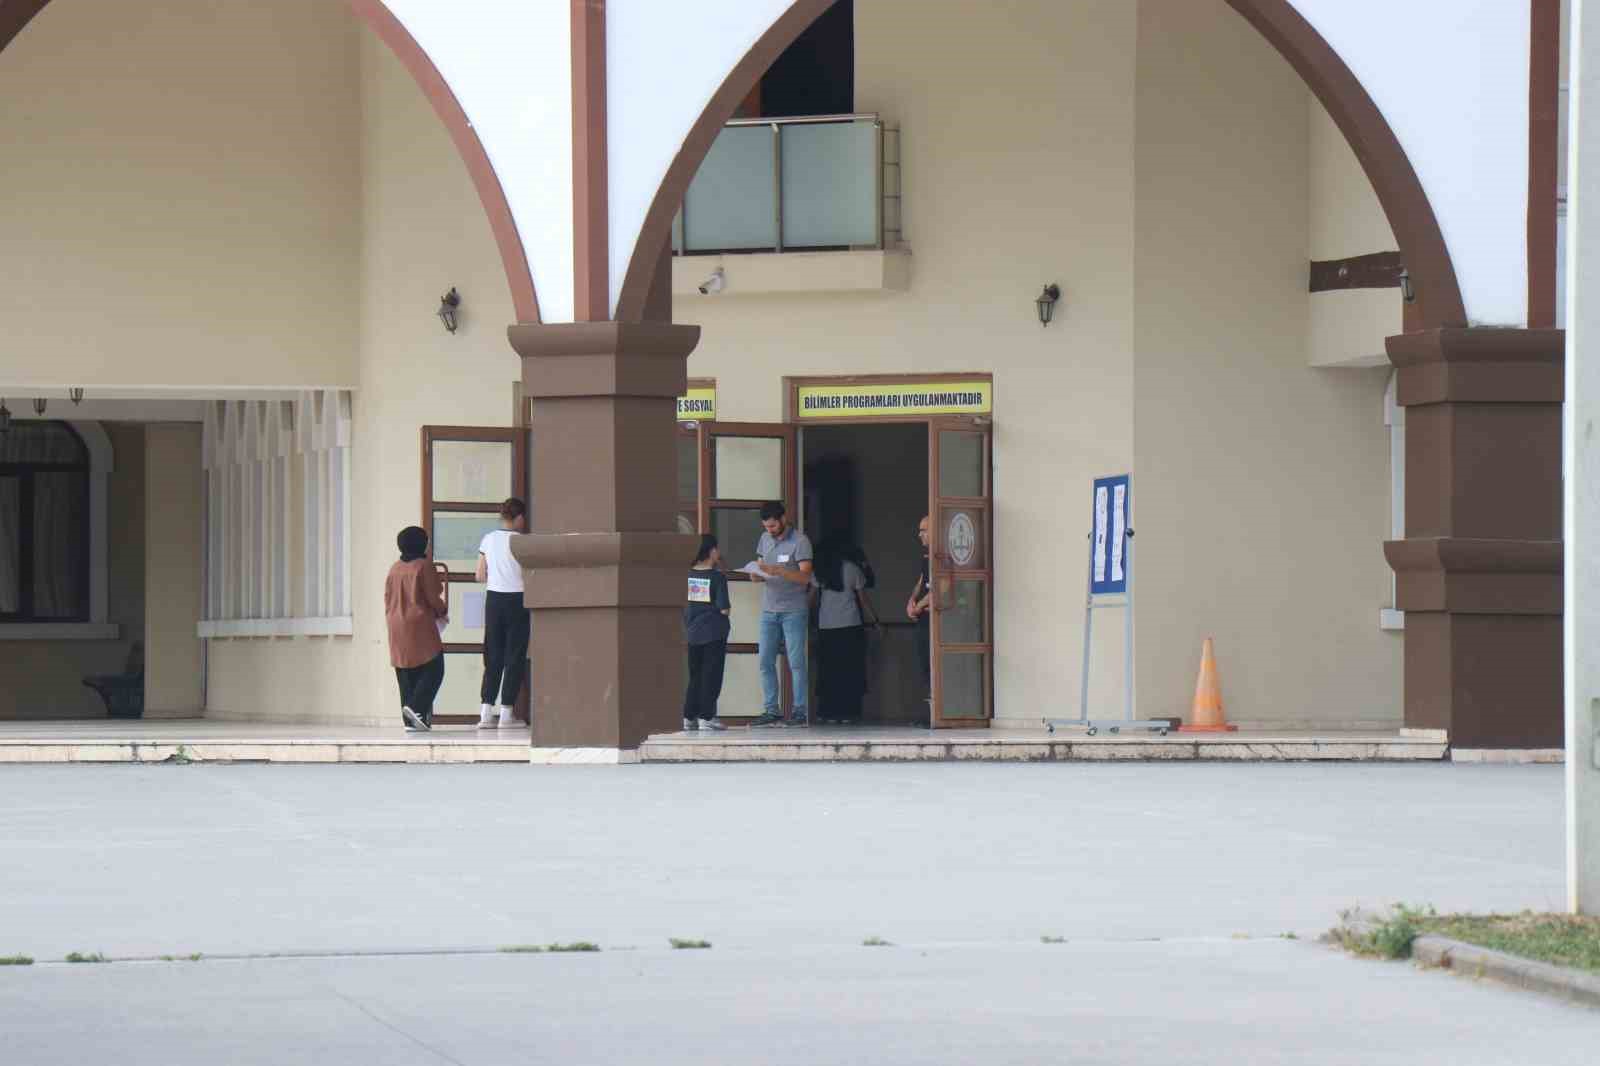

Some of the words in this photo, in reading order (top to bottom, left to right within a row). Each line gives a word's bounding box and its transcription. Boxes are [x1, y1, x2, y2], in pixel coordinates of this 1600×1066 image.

[684, 400, 712, 412] SOSYAL
[843, 394, 900, 409] PROGRAMLARI
[902, 392, 982, 407] UYGULANMAKTADIR
